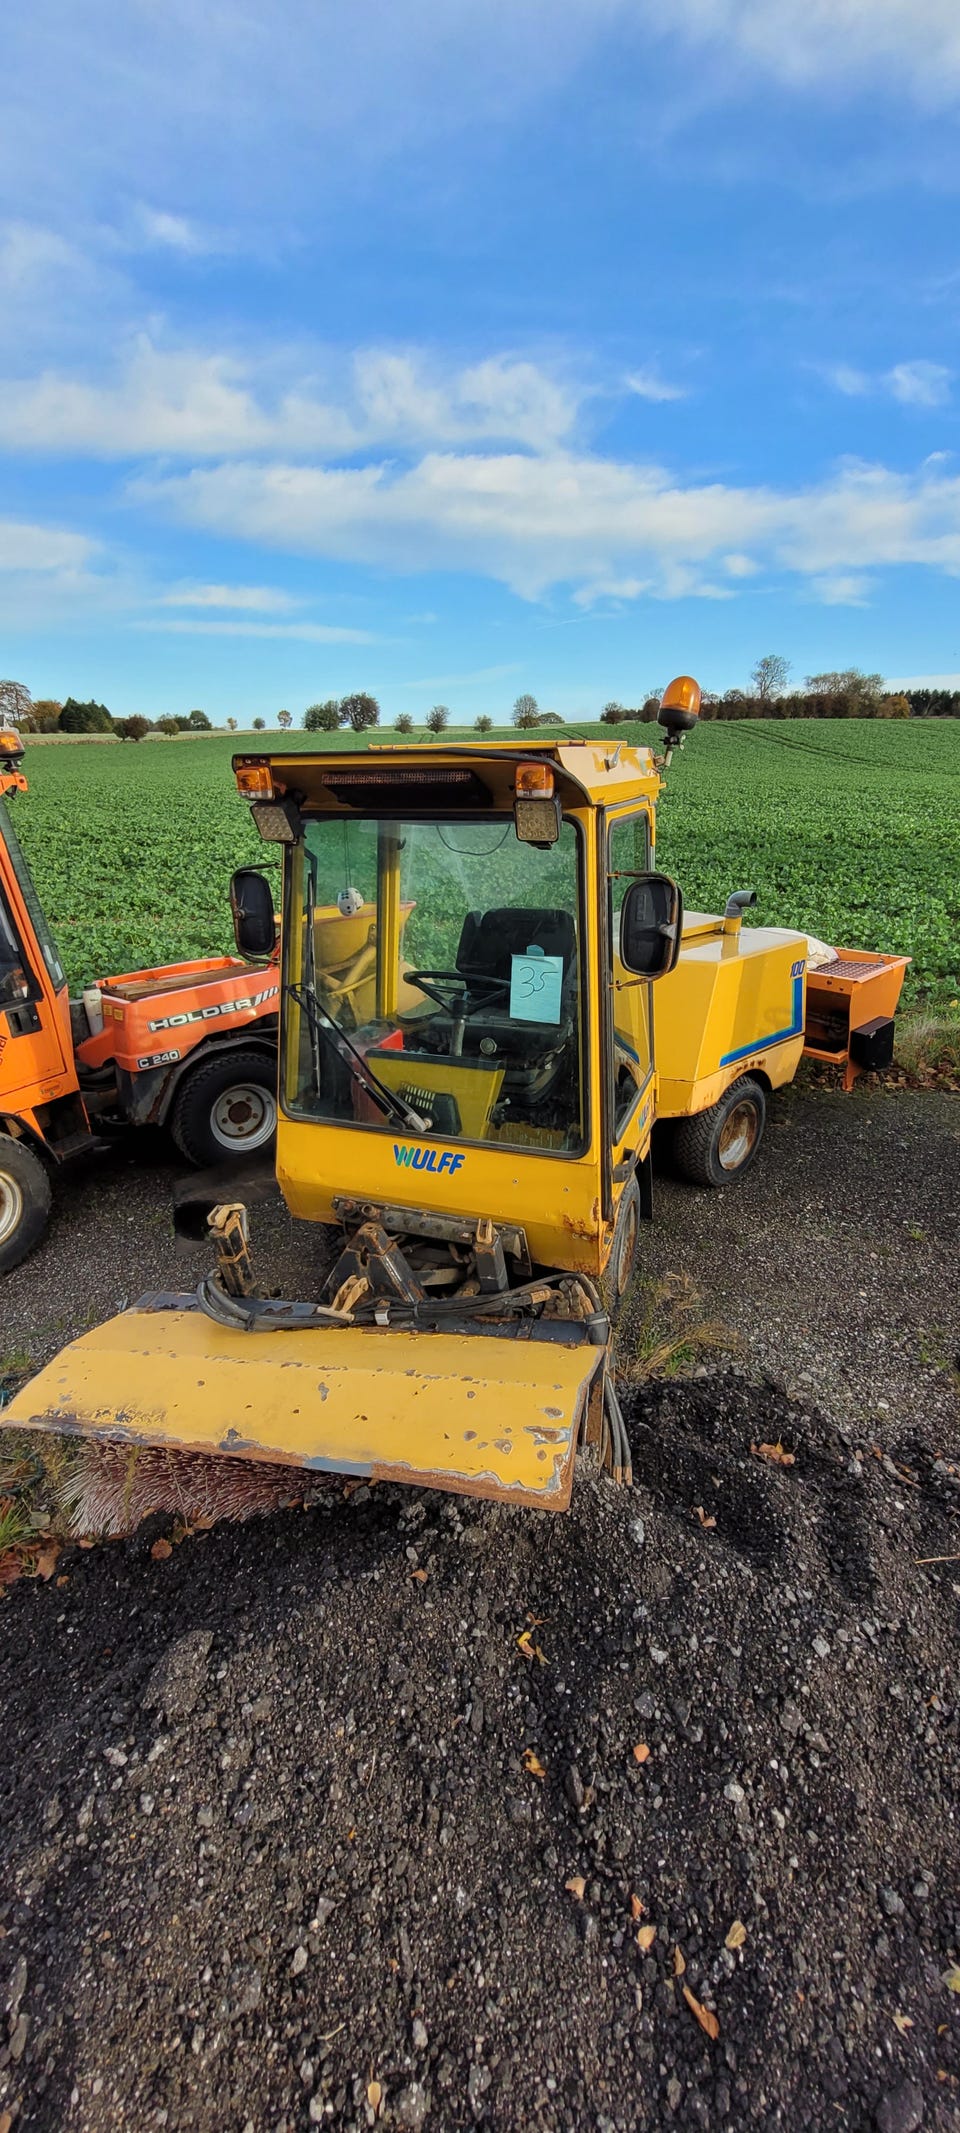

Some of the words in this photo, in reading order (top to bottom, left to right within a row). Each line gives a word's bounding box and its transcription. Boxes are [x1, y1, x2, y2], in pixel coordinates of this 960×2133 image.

[519, 966, 559, 998] 35
[790, 960, 805, 977] 100
[150, 999, 252, 1032] HOLDER
[139, 1058, 149, 1068] C
[154, 1051, 178, 1064] 240
[393, 1144, 466, 1175] WULFF
